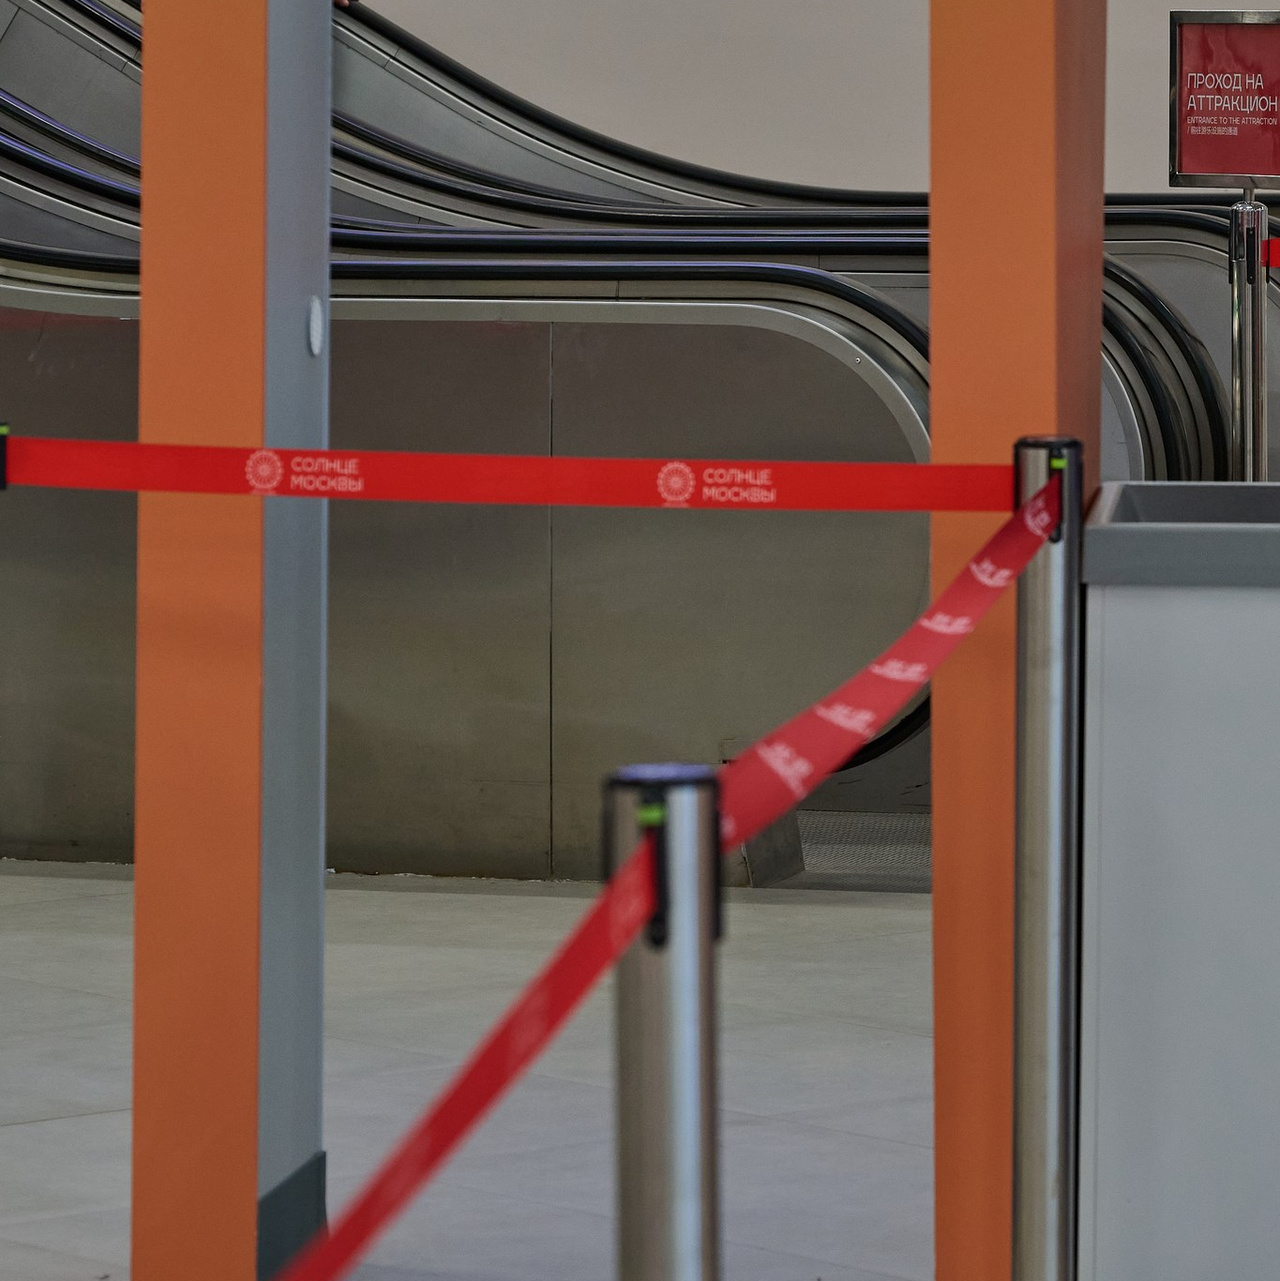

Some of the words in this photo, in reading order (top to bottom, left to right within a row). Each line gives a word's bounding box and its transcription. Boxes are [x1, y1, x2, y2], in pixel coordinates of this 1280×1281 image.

[1187, 73, 1243, 92] ПРОХОД
[1245, 74, 1264, 90] НА
[1187, 95, 1278, 115] АТТРАКЦИОН
[1187, 116, 1218, 125] ENTRANCE
[1219, 116, 1228, 125] TO
[1229, 116, 1241, 125] THE
[1241, 116, 1278, 126] ATTRACTION
[290, 456, 360, 475] СОЛНЦЕ
[290, 475, 364, 492] МОСКВЫ
[702, 467, 773, 486] СОЛНЦЕ
[702, 486, 777, 503] МОСКВЫ
